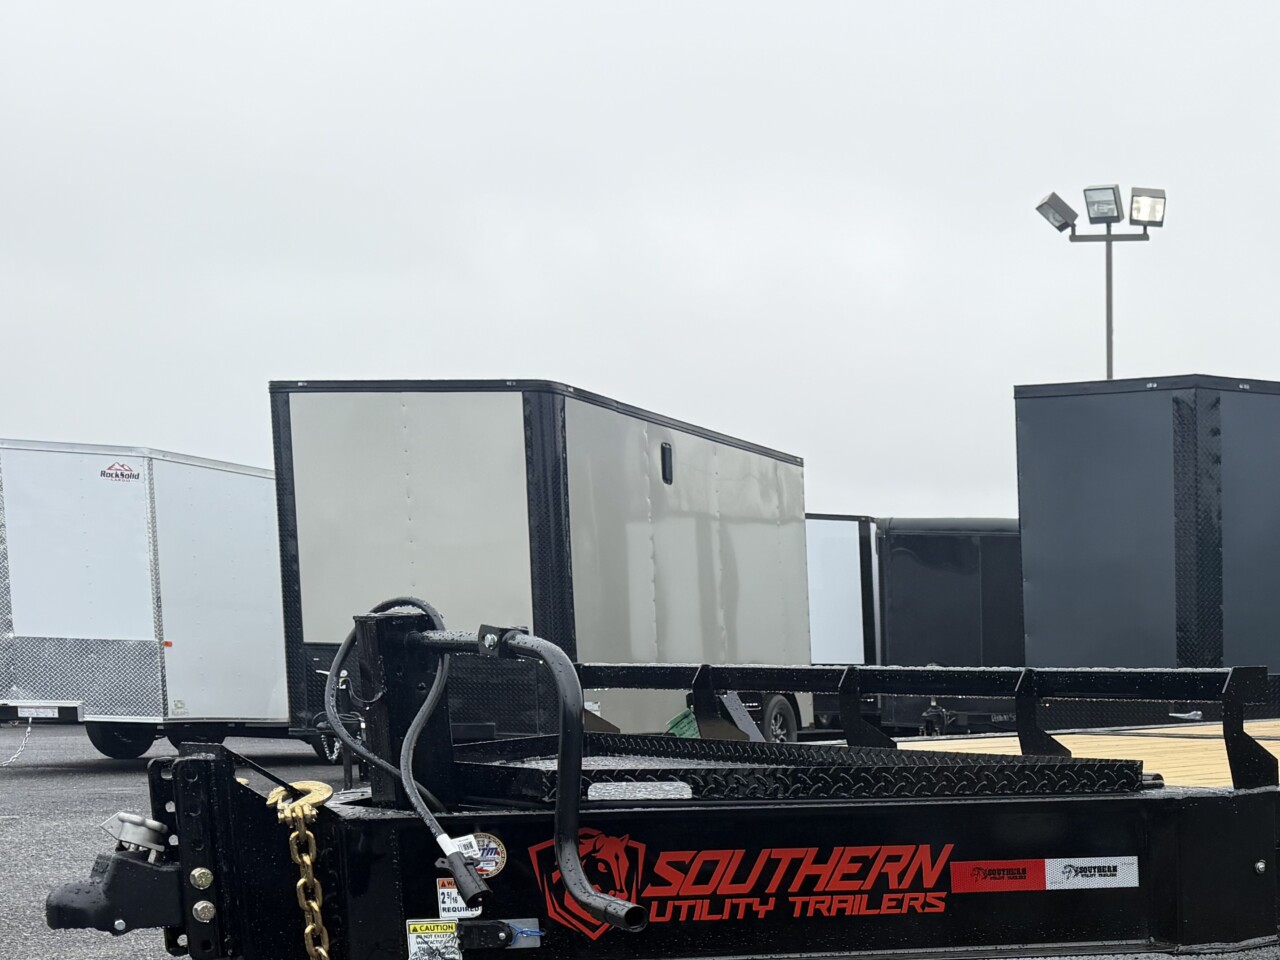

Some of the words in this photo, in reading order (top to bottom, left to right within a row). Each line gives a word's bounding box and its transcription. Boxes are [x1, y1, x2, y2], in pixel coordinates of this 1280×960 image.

[100, 470, 140, 480] RockSolid
[641, 844, 954, 897] SOUTHERN
[1079, 865, 1118, 874] SOUTHERN
[440, 891, 447, 905] 2
[442, 905, 480, 913] REQUIRED
[649, 897, 776, 923] UTILITY
[788, 892, 947, 917] TRAILERS
[419, 924, 454, 932] CAUTION
